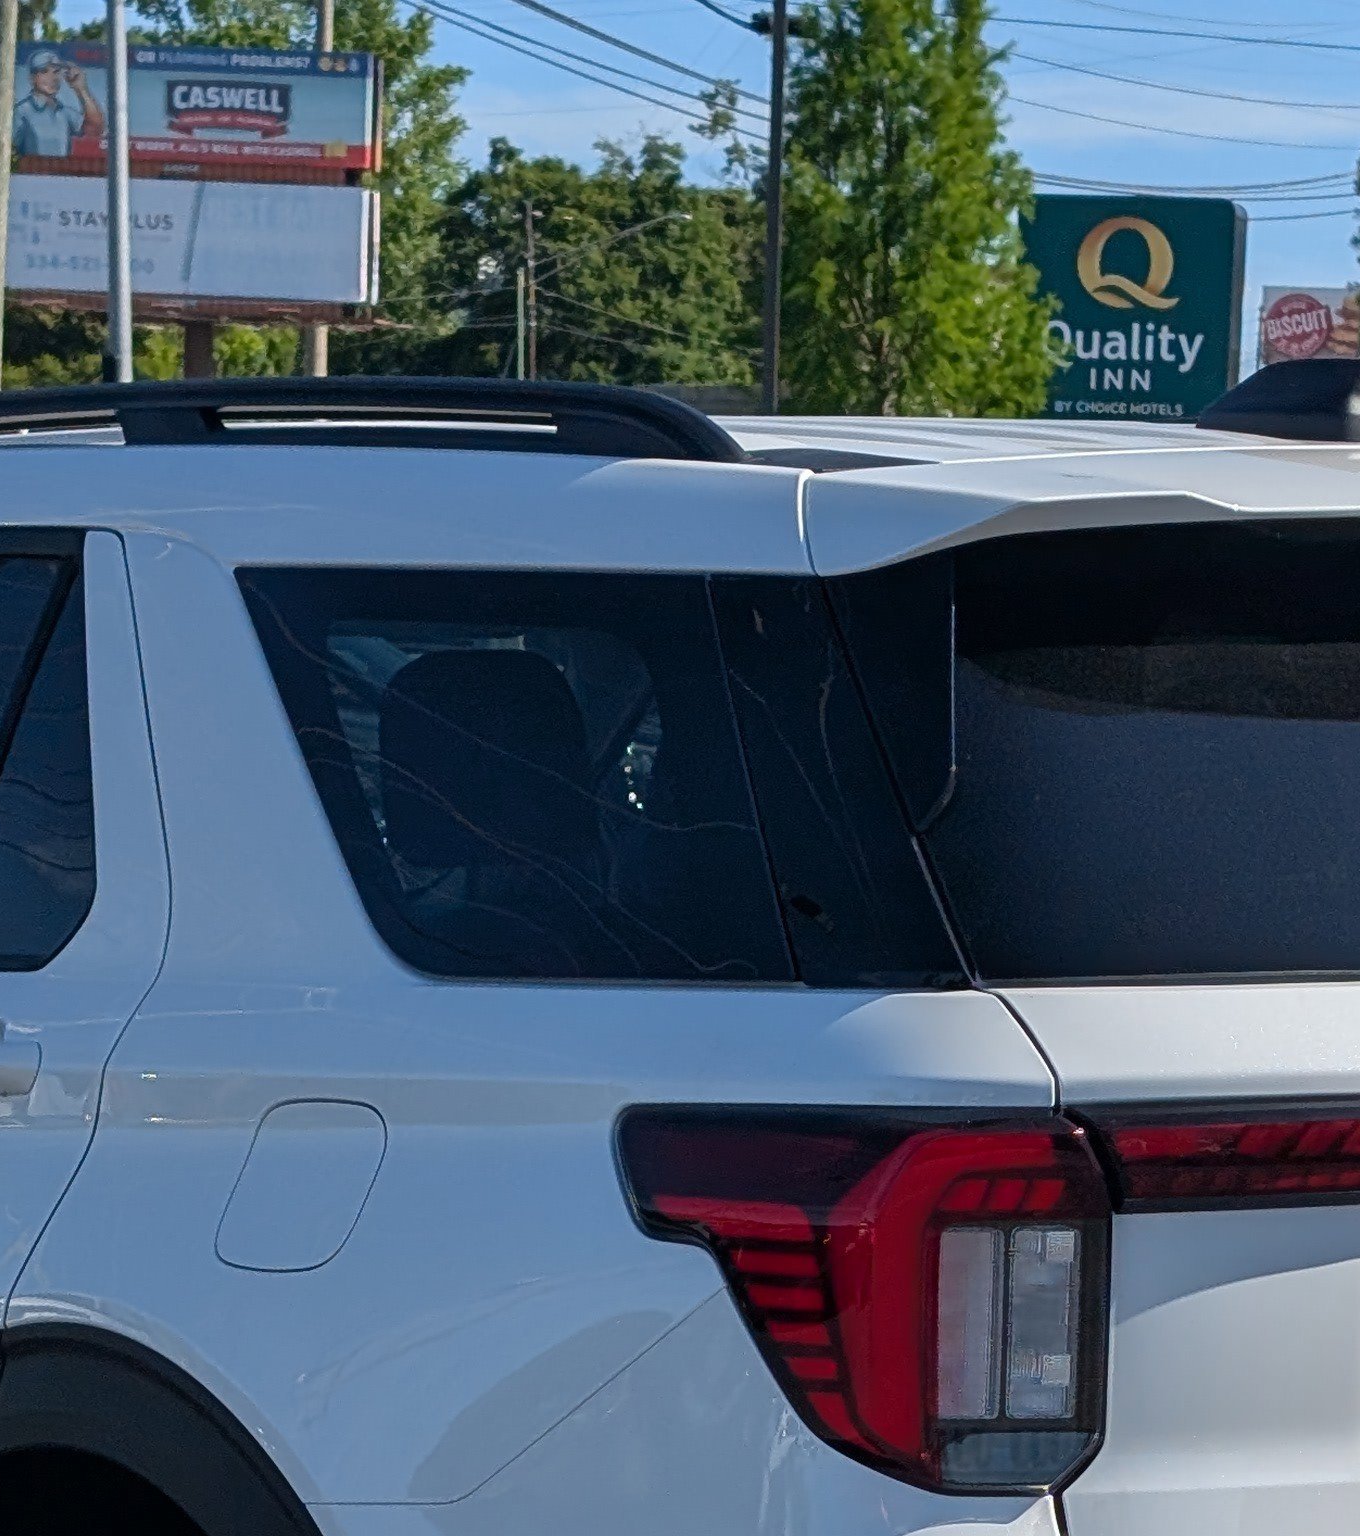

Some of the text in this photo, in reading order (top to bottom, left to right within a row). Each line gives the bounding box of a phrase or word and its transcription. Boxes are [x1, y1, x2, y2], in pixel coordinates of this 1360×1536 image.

[172, 85, 284, 114] CASWELL
[132, 213, 174, 232] LUS
[1265, 308, 1328, 340] BISCUIT
[1042, 319, 1206, 373] Quality
[1089, 367, 1153, 393] INN
[1053, 400, 1185, 418] BY CHOICE HOTELS
